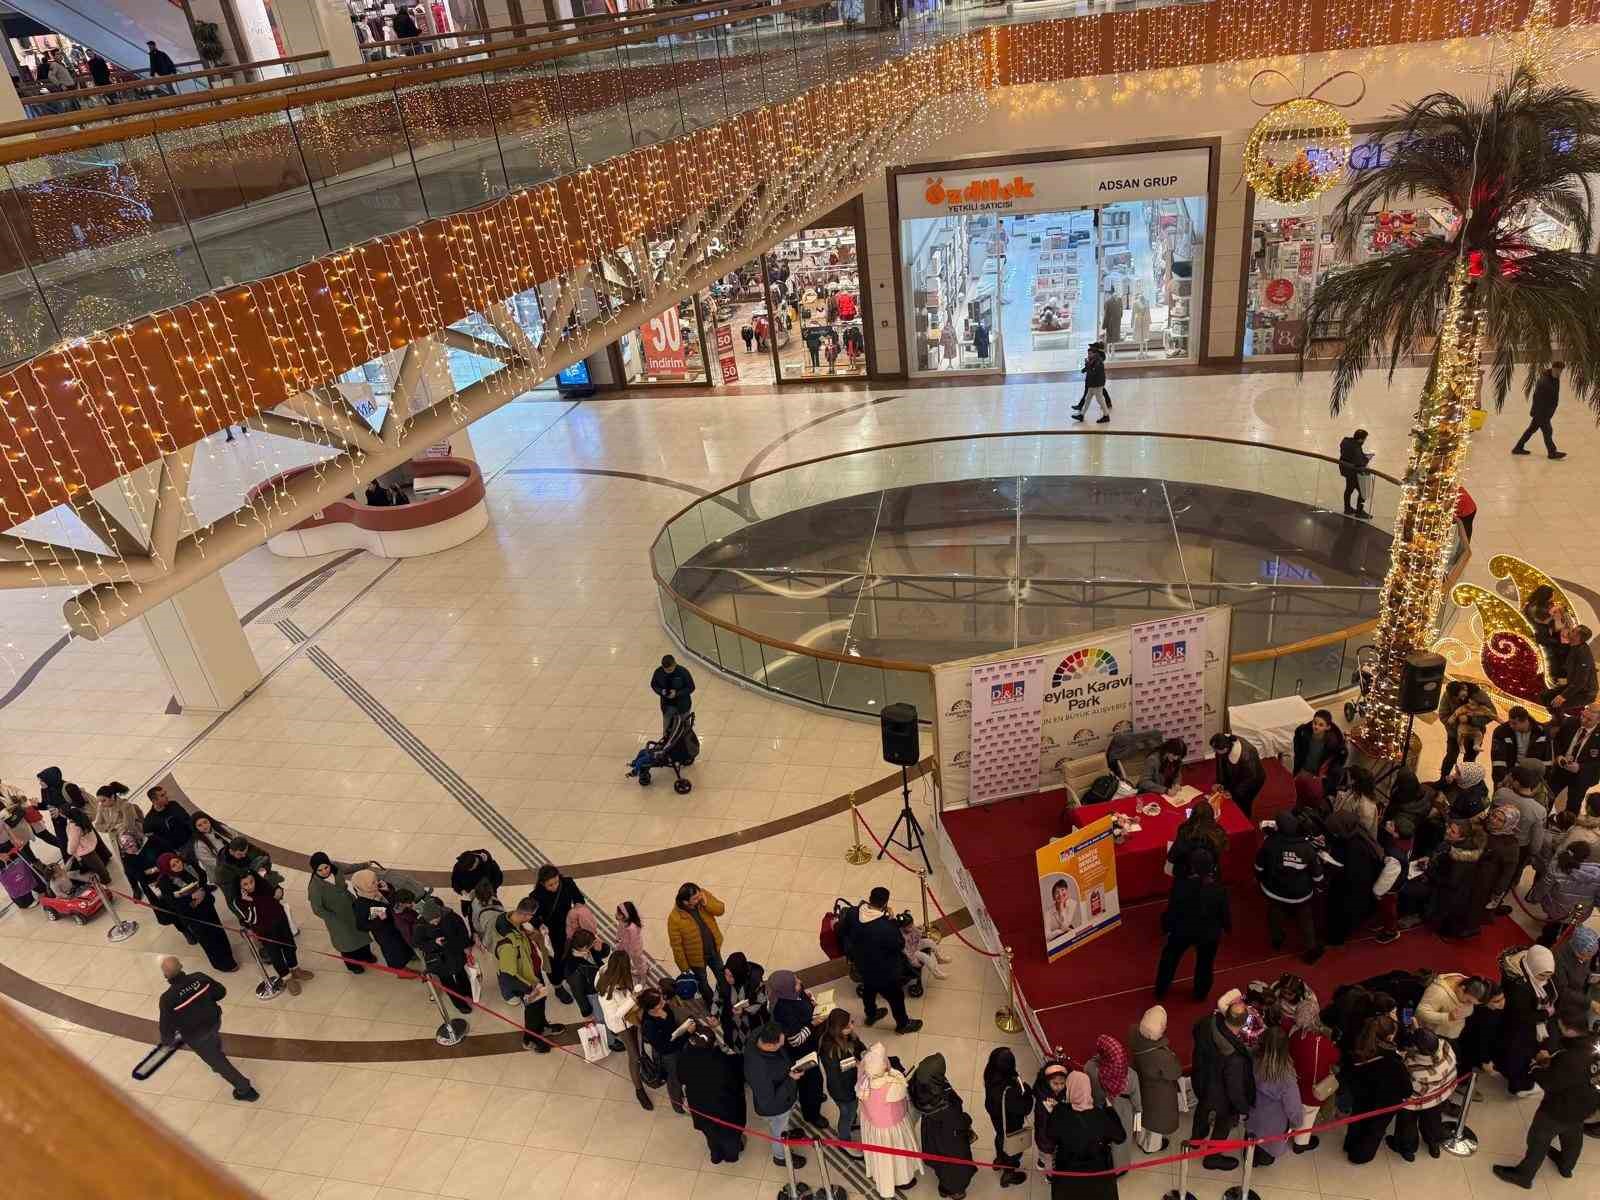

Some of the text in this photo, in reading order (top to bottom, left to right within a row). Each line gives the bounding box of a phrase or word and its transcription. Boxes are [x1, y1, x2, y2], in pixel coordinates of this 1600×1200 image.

[926, 175, 1035, 206] Özdilek
[1099, 175, 1178, 192] ADSAN GRUP
[717, 334, 730, 347] 50
[648, 357, 685, 369] indirim
[723, 366, 737, 378] 50
[1153, 645, 1185, 661] D&R
[992, 686, 1024, 700] D&R
[1043, 686, 1084, 704] eylan
[1068, 695, 1101, 711] Park
